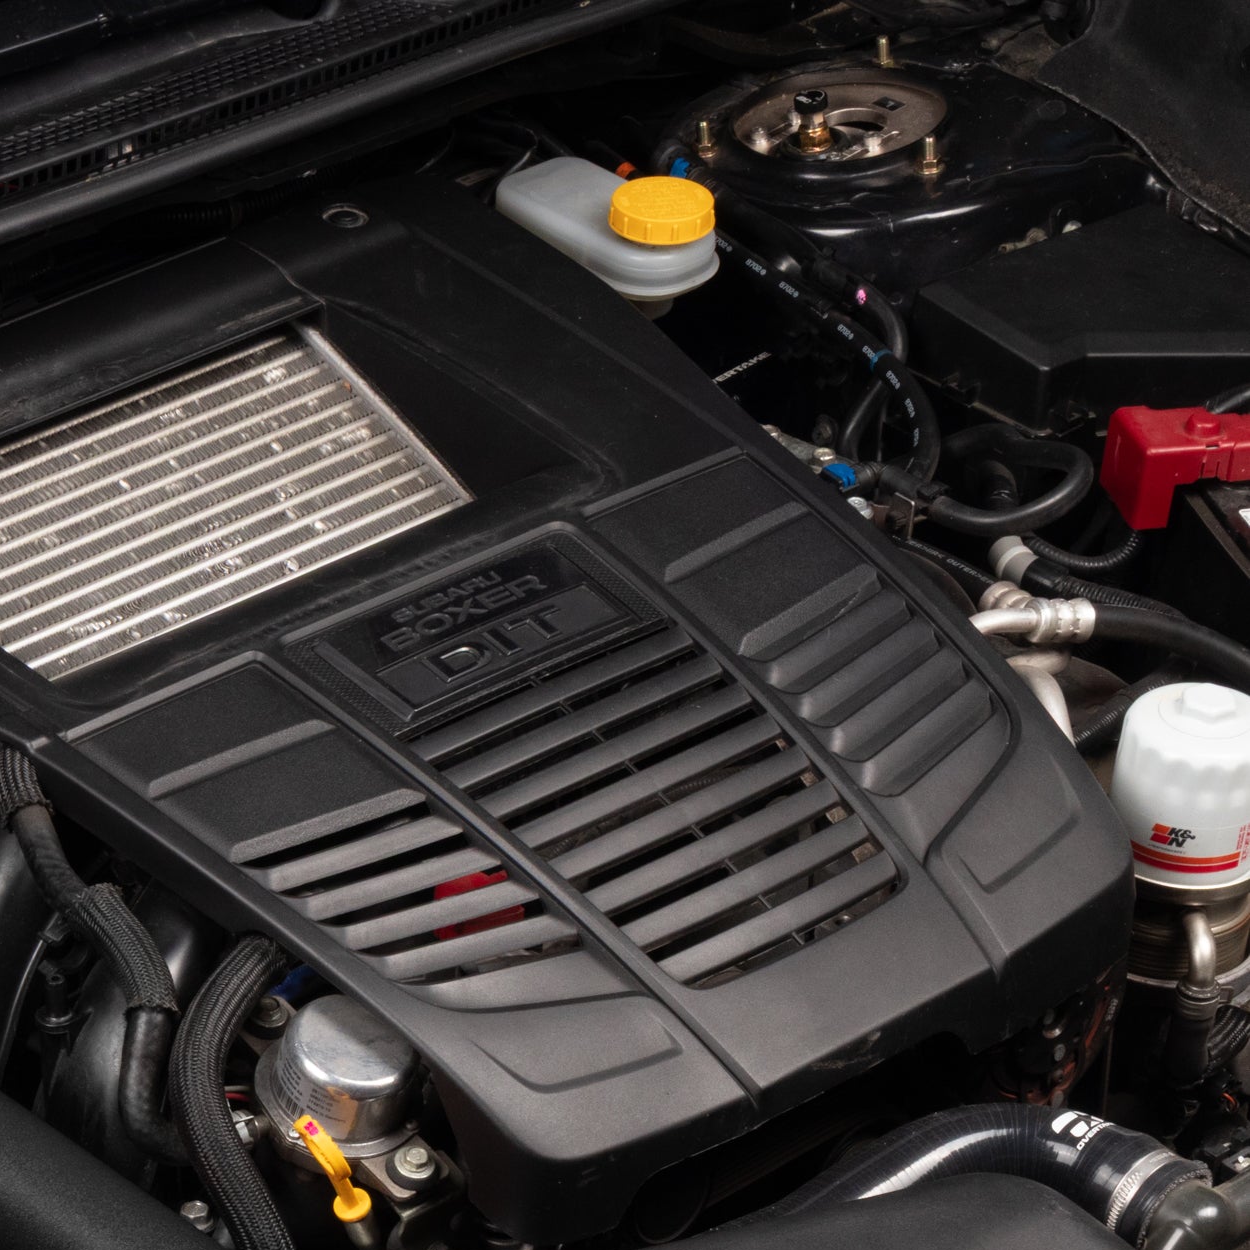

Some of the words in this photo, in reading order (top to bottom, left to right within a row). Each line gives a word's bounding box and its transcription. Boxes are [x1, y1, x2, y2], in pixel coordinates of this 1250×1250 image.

[712, 351, 772, 385] ERTAKE
[380, 575, 548, 652] BOXER
[390, 570, 502, 623] SUBARU
[420, 605, 563, 683] DIT
